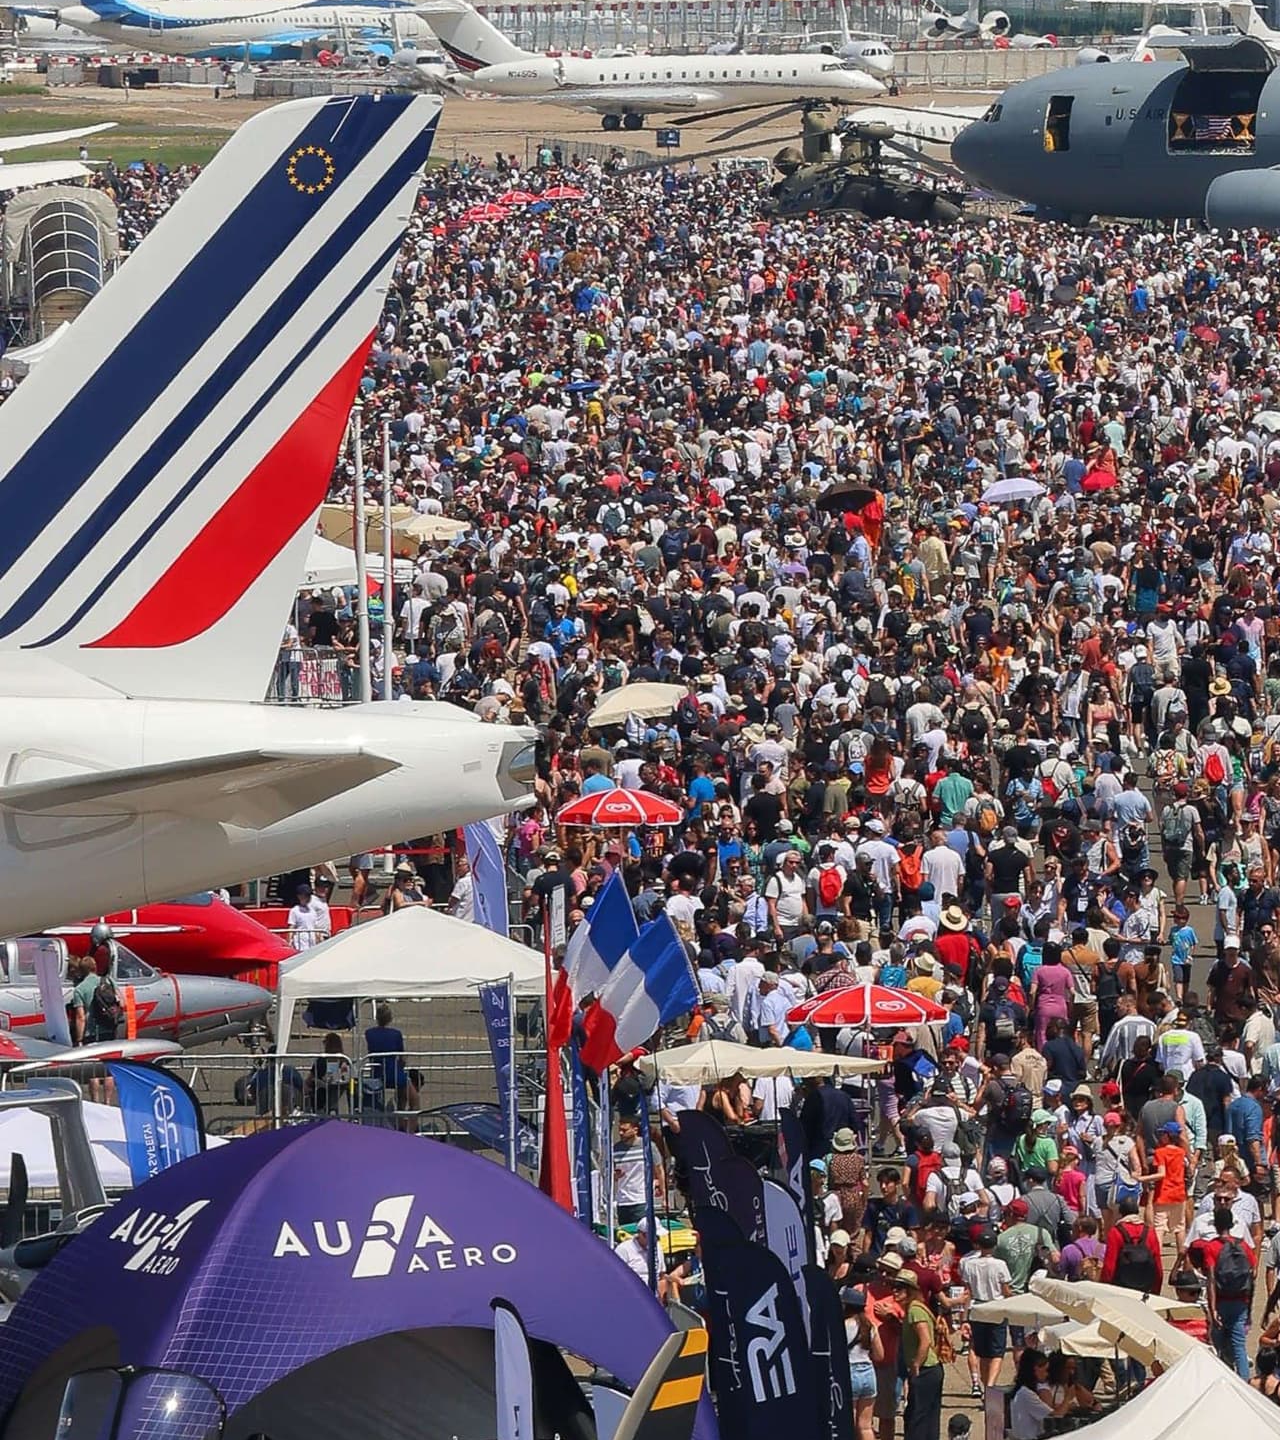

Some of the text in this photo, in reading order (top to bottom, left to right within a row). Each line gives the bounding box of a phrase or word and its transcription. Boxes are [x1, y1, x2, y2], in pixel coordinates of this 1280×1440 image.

[273, 1195, 455, 1279] AURA
[142, 1254, 179, 1275] AERO
[407, 1243, 518, 1274] AERO
